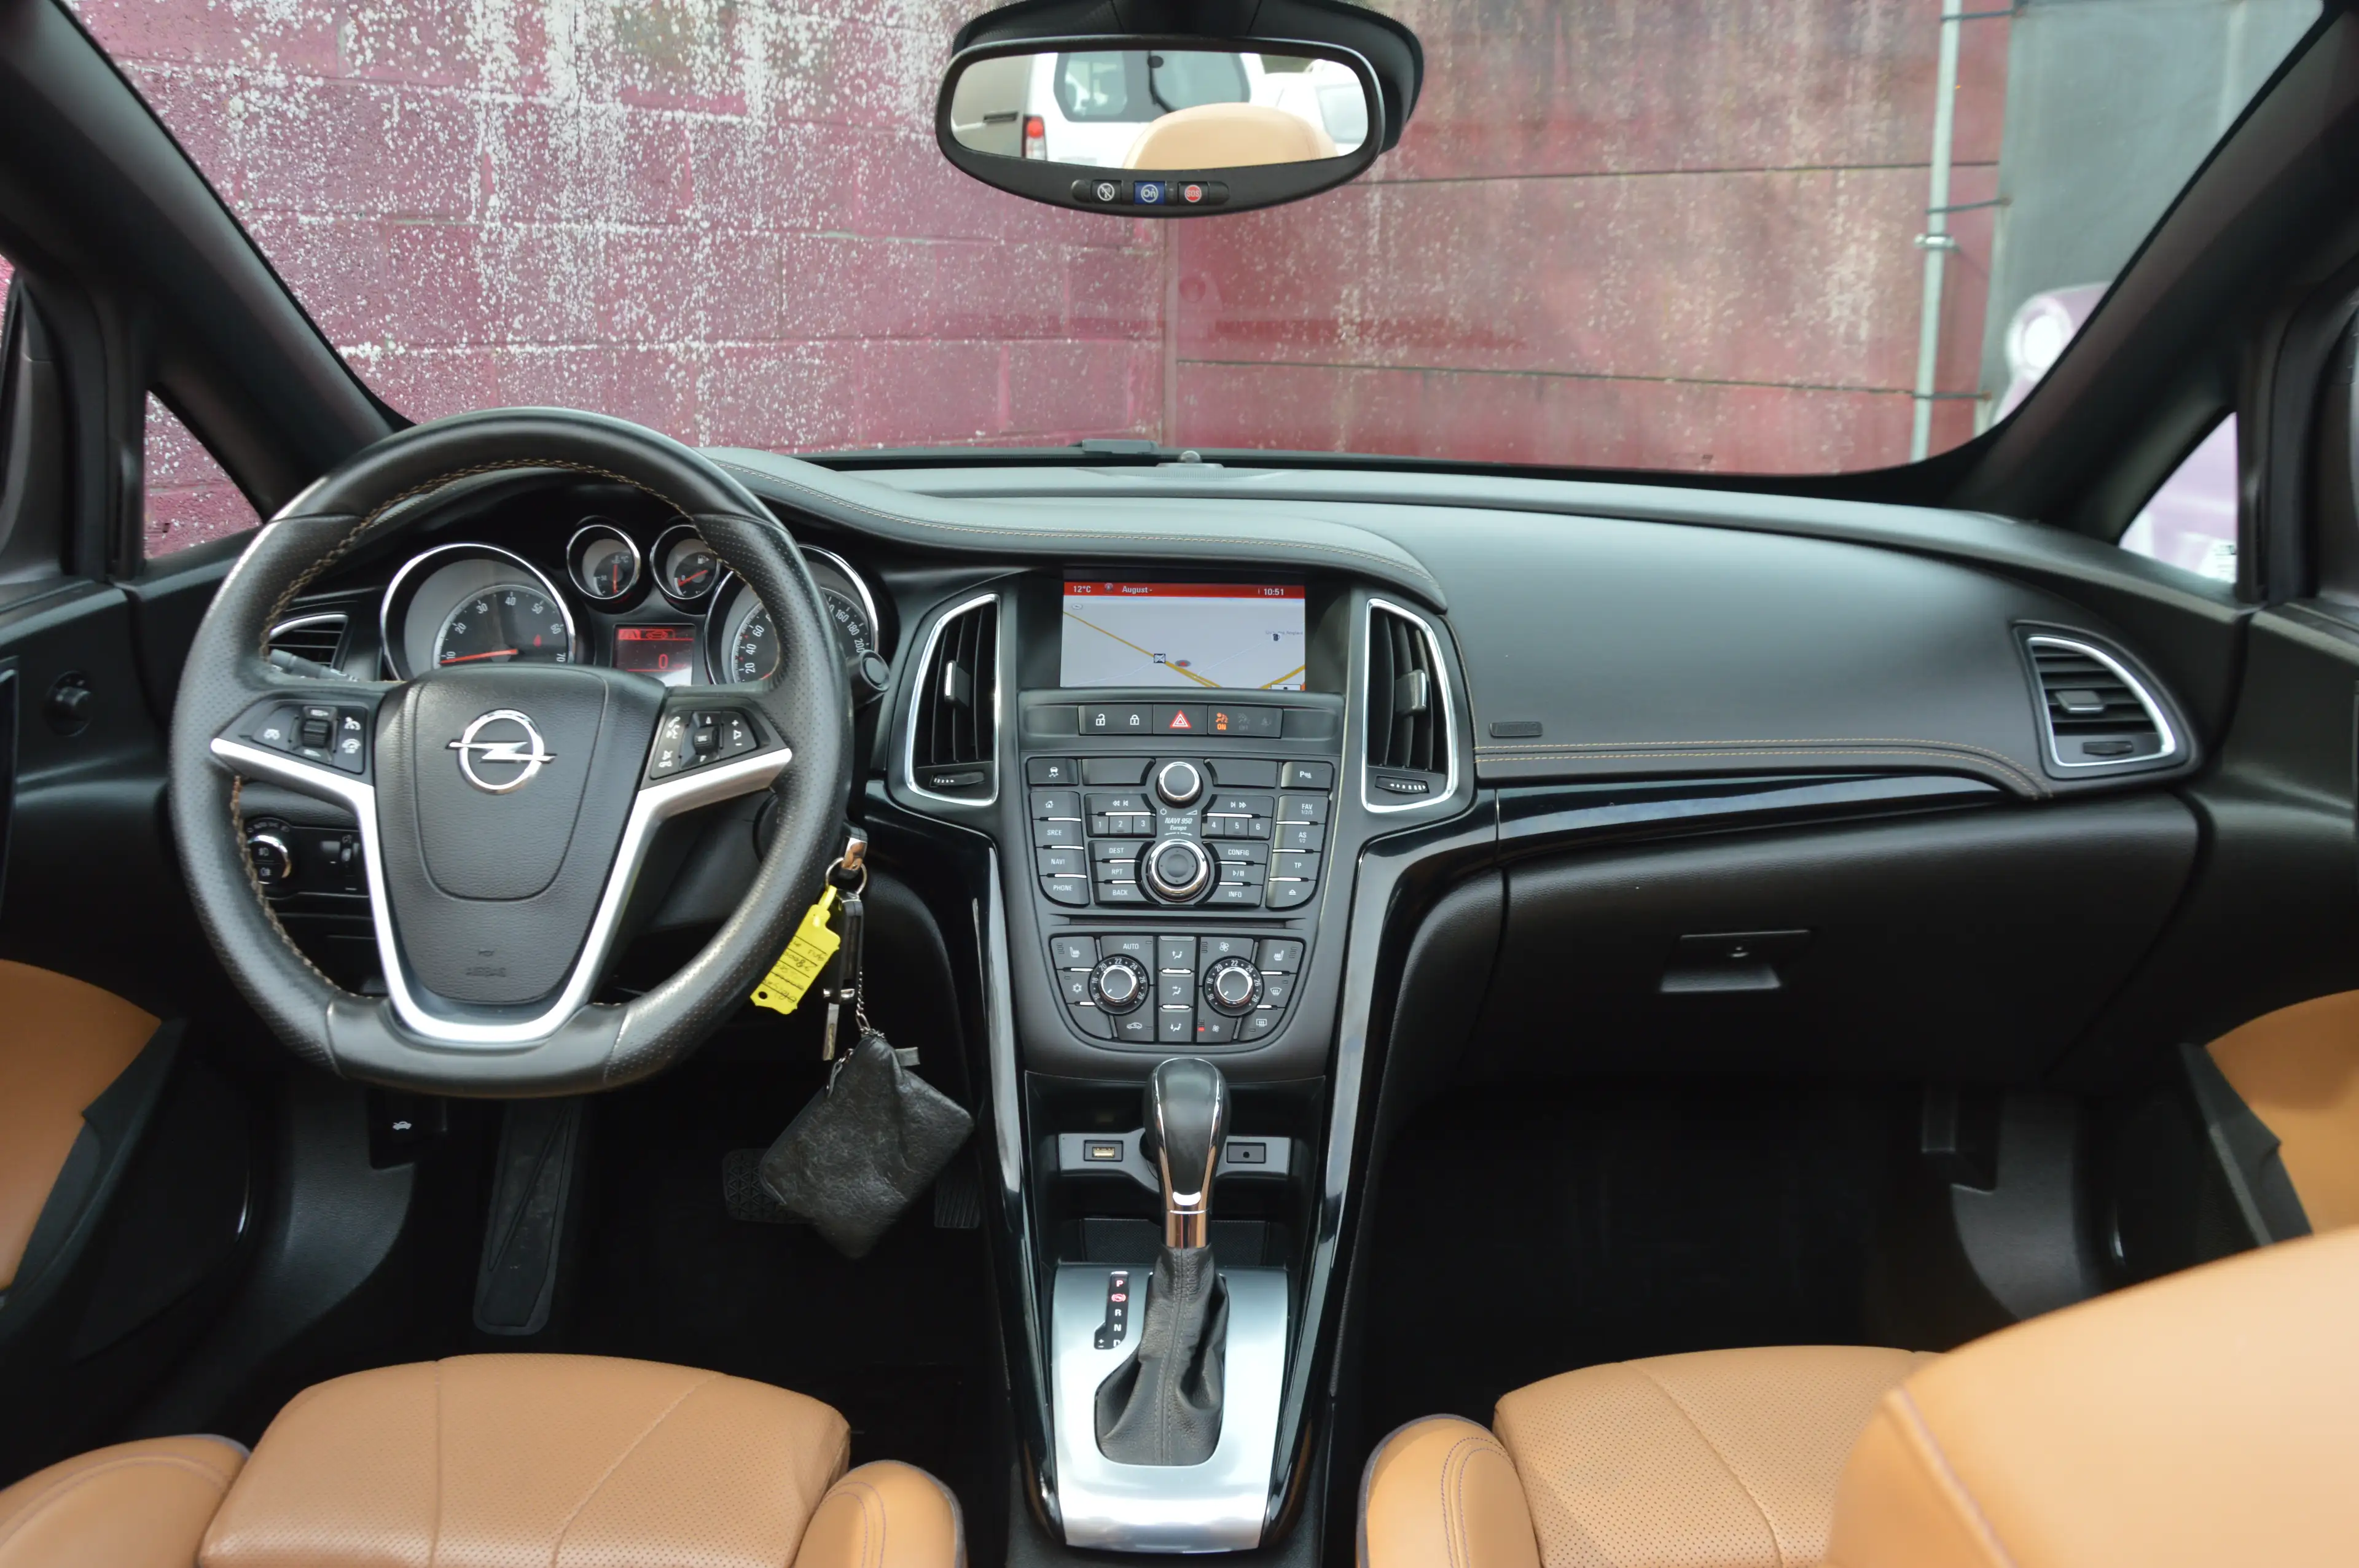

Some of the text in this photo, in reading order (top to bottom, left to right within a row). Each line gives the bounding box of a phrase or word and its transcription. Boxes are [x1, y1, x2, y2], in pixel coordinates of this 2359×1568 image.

[1122, 585, 1148, 594] August
[505, 597, 516, 606] 40
[476, 603, 488, 614] 30
[531, 603, 544, 614] 50
[835, 609, 850, 623] 160
[455, 622, 467, 634] 20
[550, 623, 561, 634] 60
[752, 625, 764, 637] 60
[847, 622, 860, 636] 180
[746, 643, 757, 655] 40
[854, 638, 865, 653] 200
[557, 652, 566, 662] 70
[659, 653, 668, 669] 0
[745, 662, 756, 674] 20
[1215, 964, 1223, 972] 20
